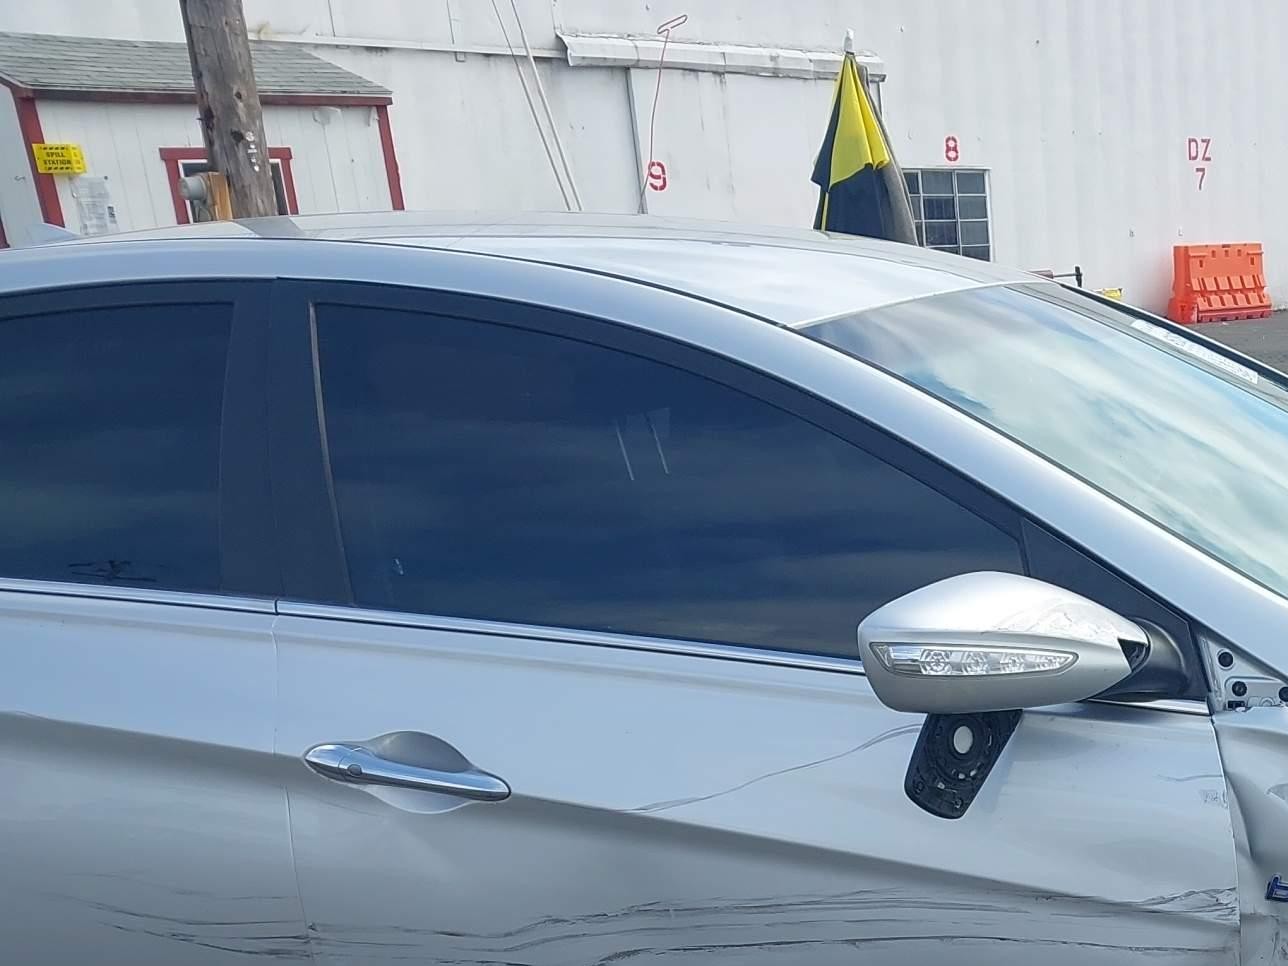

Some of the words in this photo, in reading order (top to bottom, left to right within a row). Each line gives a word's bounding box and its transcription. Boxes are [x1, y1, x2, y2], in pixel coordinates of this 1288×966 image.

[945, 135, 959, 162] 8
[1188, 137, 1212, 162] DZ
[648, 161, 667, 191] 9
[1195, 167, 1206, 191] 7
